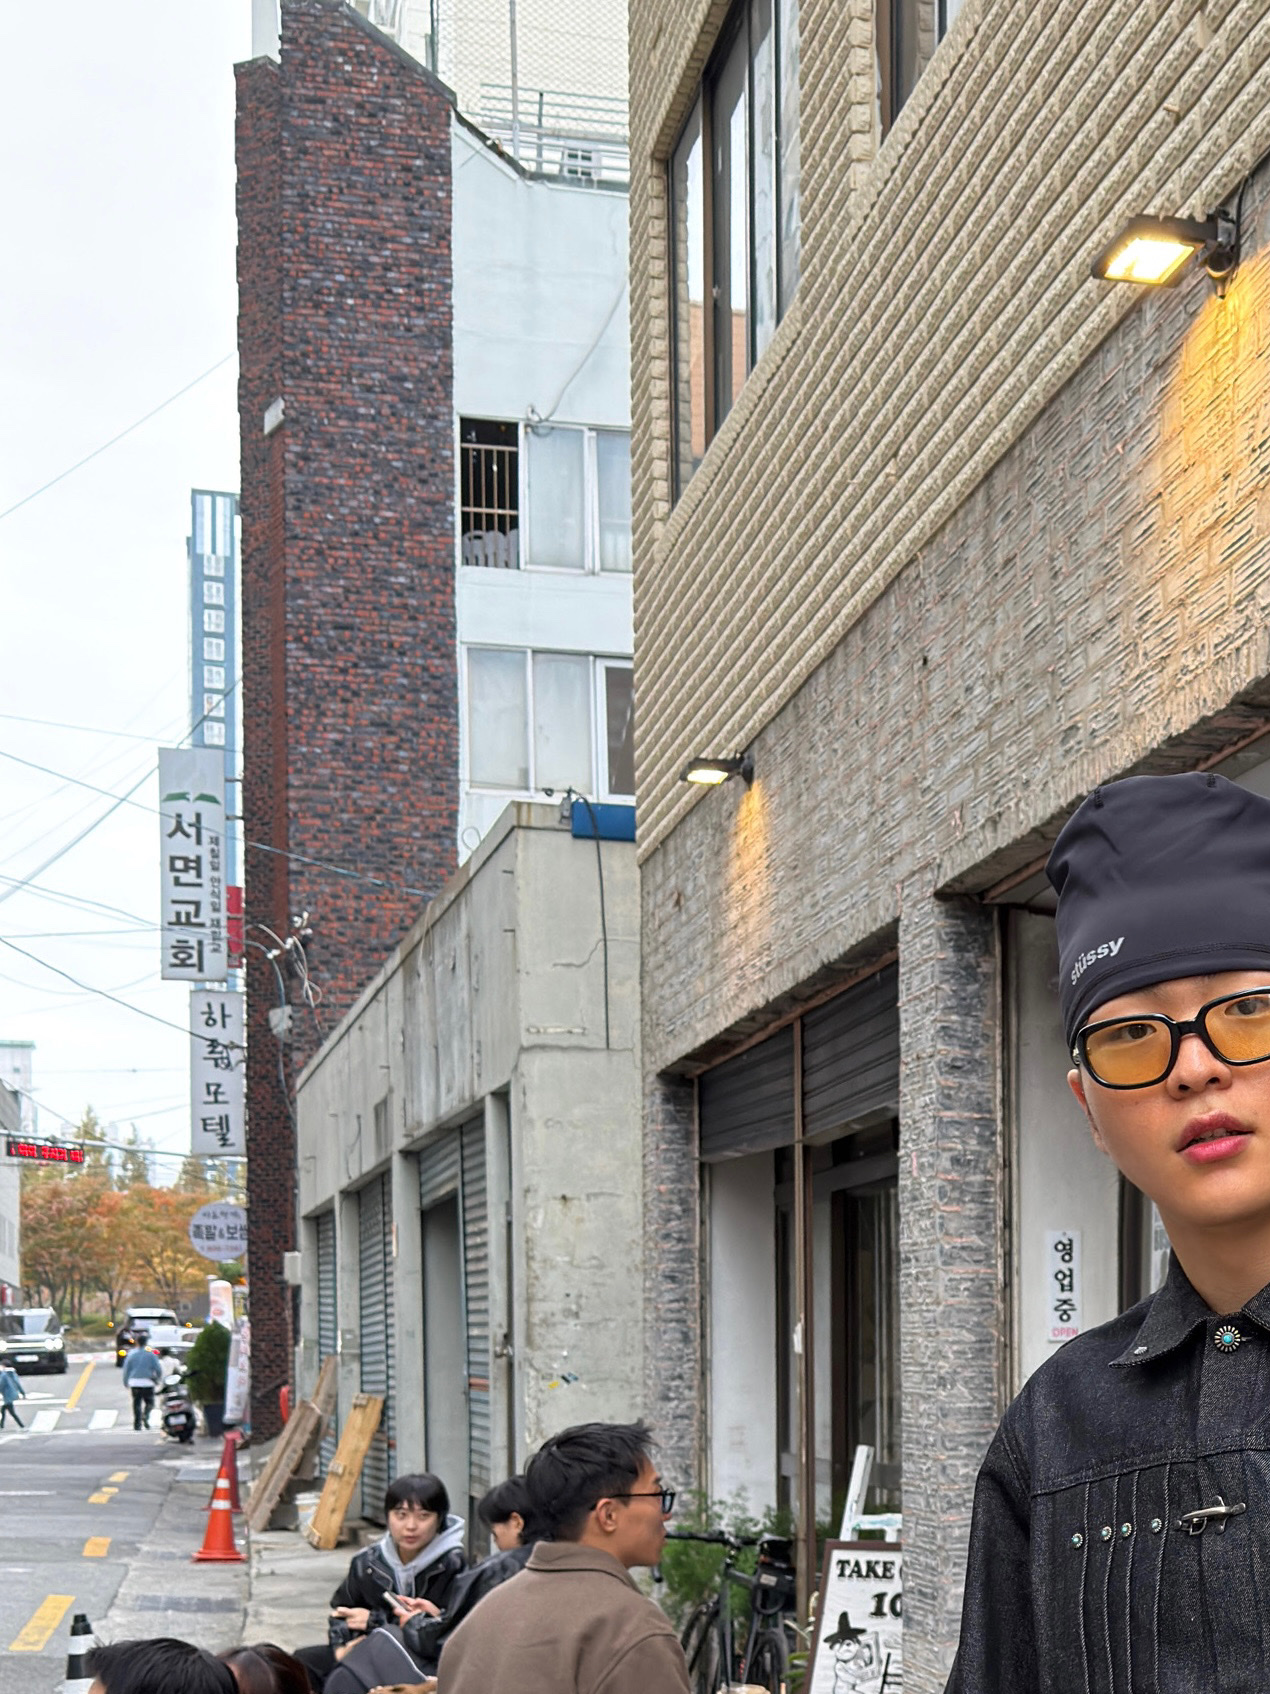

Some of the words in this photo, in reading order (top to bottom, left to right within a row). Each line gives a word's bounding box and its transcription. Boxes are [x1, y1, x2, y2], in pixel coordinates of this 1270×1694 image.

[166, 811, 206, 974] 서면교회
[1071, 936, 1125, 986] stüssy
[1054, 1238, 1077, 1323] 영업중
[1052, 1327, 1079, 1338] OPEN
[836, 1559, 895, 1580] TAKE
